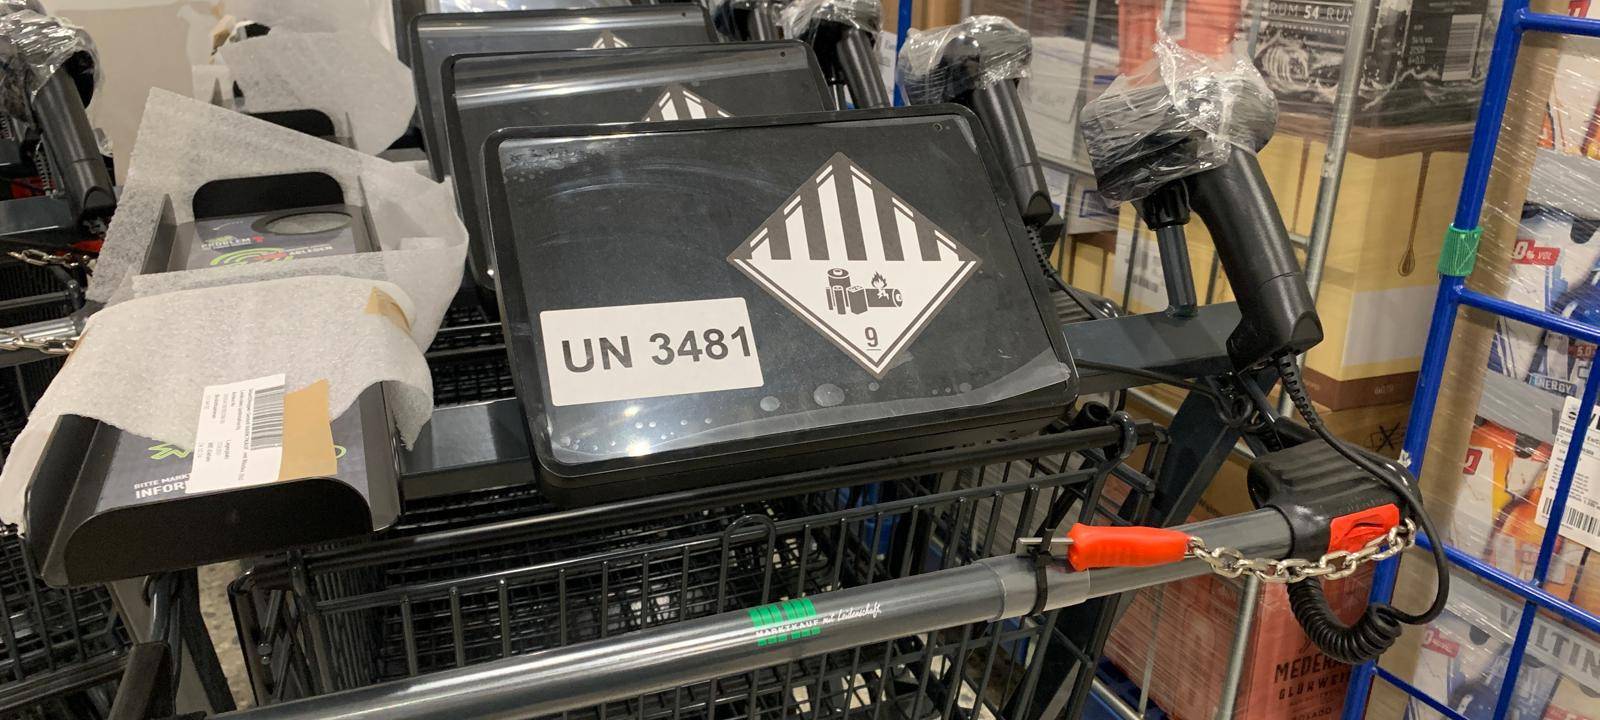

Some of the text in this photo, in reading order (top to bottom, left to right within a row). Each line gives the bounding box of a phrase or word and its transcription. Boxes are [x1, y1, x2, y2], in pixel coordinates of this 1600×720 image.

[1269, 2, 1298, 17] RUM
[1303, 5, 1320, 19] 54
[864, 326, 879, 348] 9
[562, 326, 751, 373] UN 3481
[755, 619, 820, 637] MARKTKAUF
